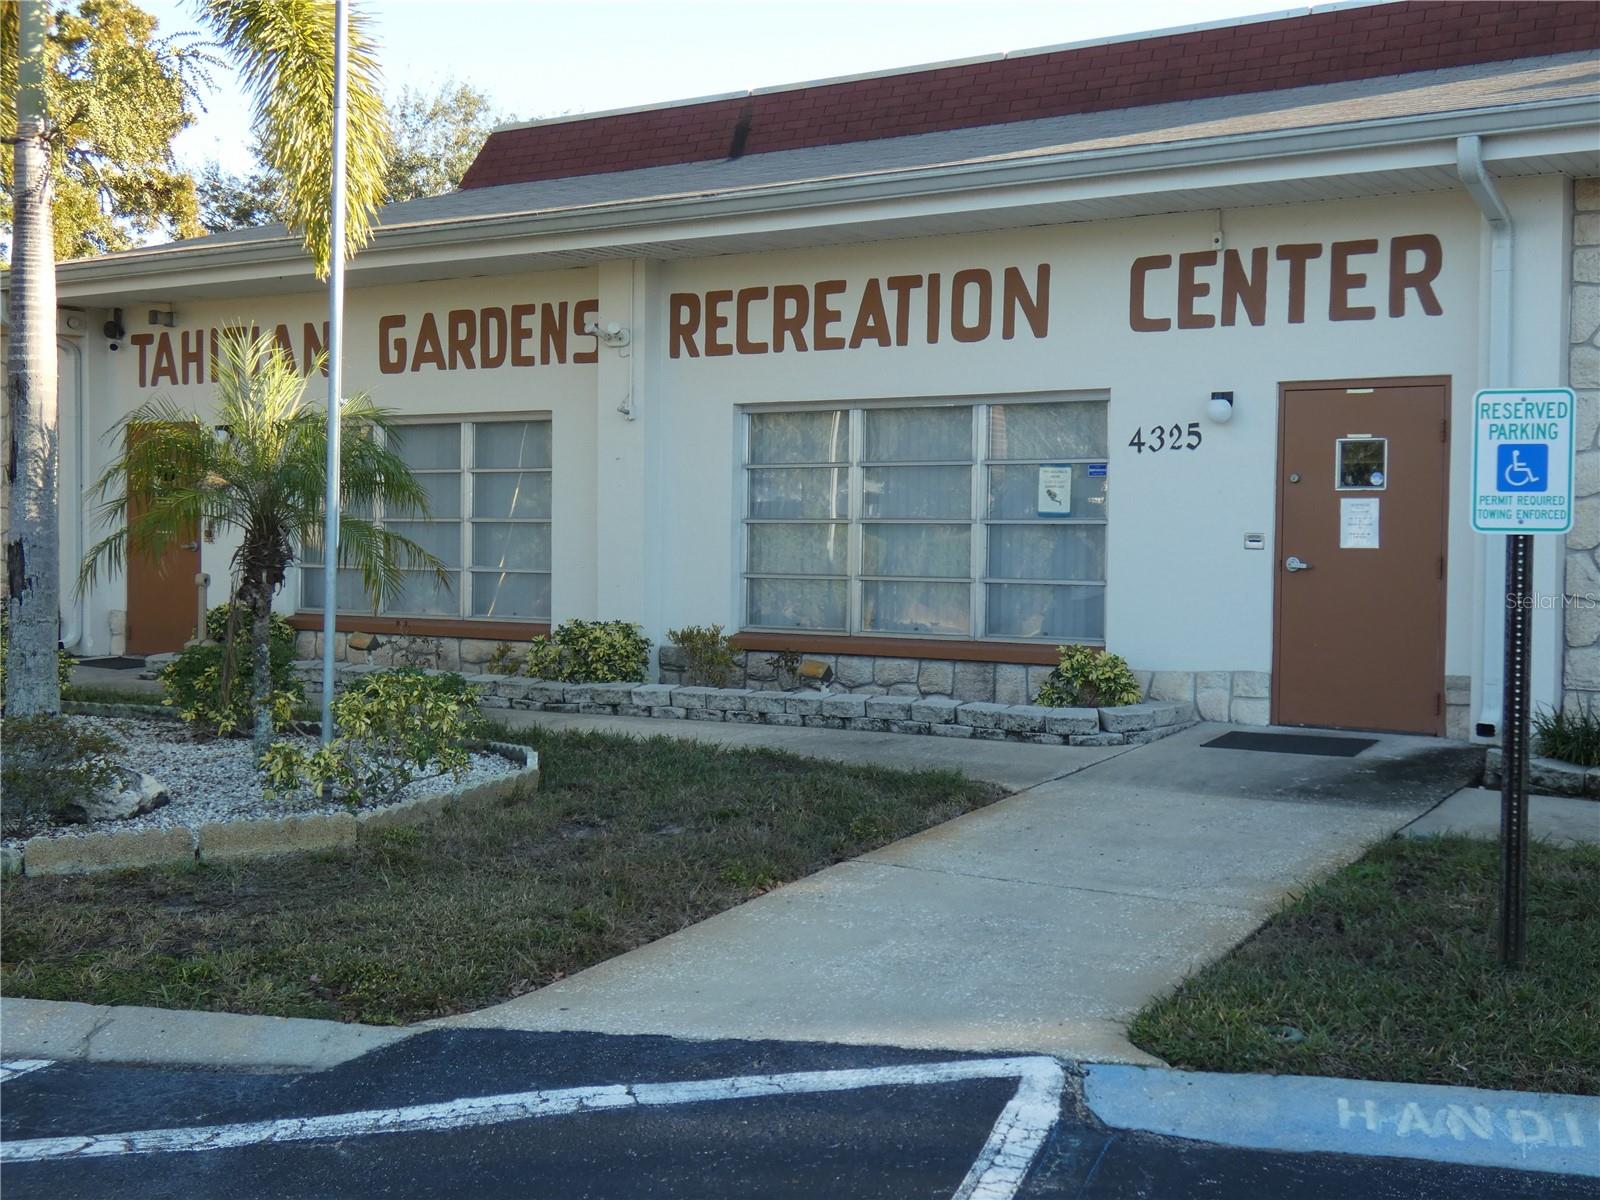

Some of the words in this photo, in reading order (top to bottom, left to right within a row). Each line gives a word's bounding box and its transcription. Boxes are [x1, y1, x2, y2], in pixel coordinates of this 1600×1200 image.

[378, 299, 599, 375] GARDENS
[669, 263, 1051, 359] RECREATION
[1130, 233, 1443, 332] CENTER
[1480, 402, 1568, 420] RESERVED
[1128, 422, 1203, 454] 4325
[1488, 422, 1559, 441] PARKING
[1479, 495, 1513, 506] PERMIT
[1517, 495, 1566, 506] REQUIRED
[1477, 508, 1513, 520] TOWING
[1516, 508, 1567, 520] ENFORCED
[1337, 1097, 1600, 1148] HANDI
